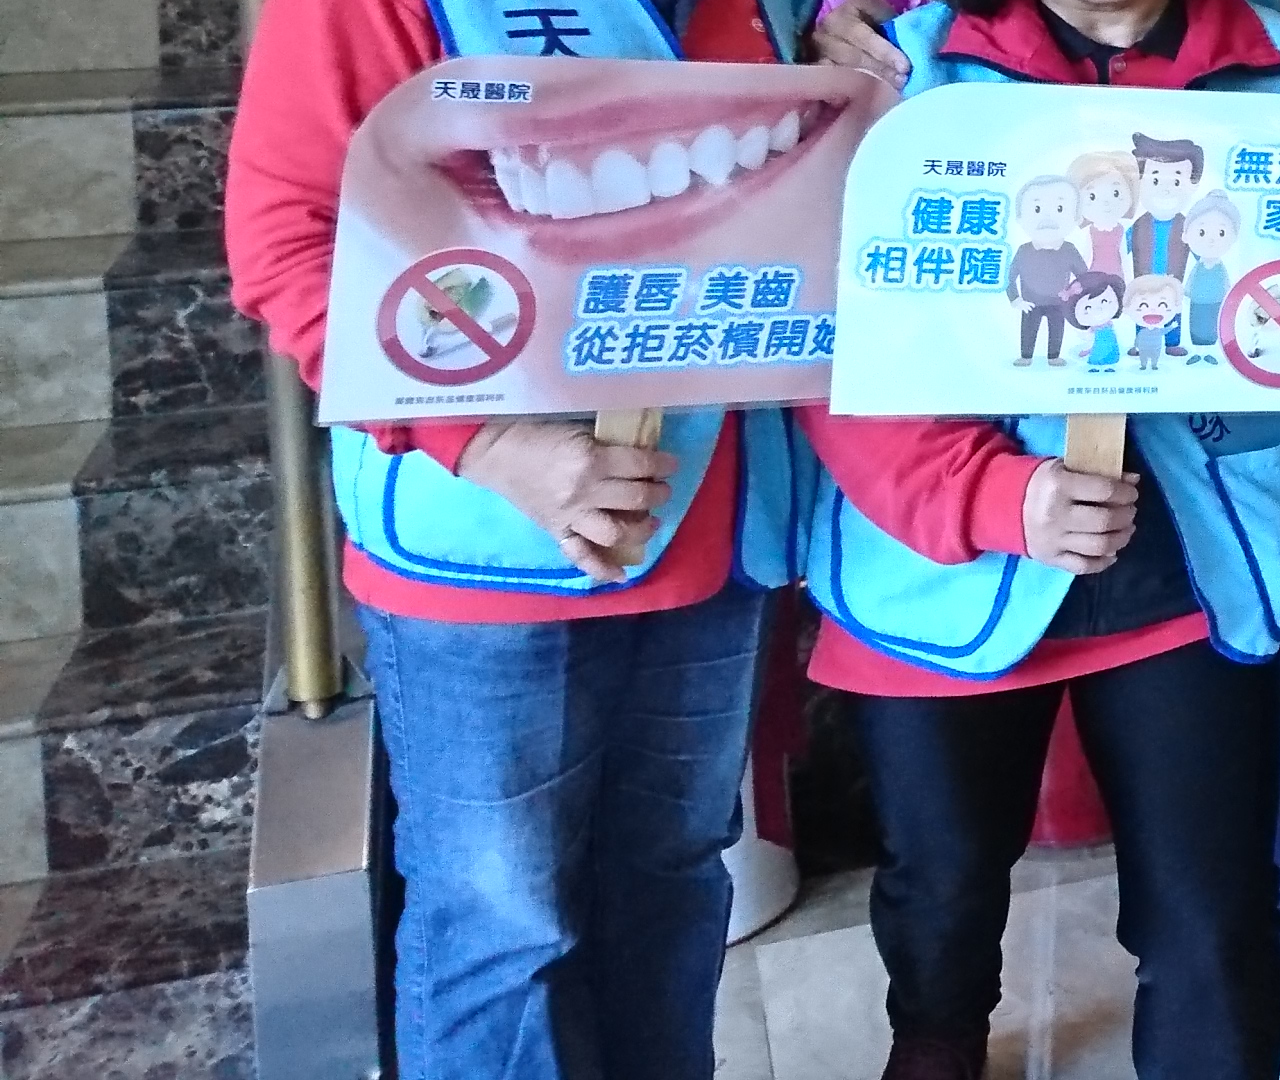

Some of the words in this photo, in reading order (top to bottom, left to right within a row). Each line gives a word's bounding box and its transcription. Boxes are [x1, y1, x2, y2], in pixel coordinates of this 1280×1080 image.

[433, 79, 531, 103] 天晟醫院
[922, 159, 1007, 178] 天晟醫院
[911, 197, 1001, 237] 健康
[865, 247, 1005, 288] 相伴隨
[583, 272, 676, 314] 護唇
[700, 270, 797, 309] 美齒
